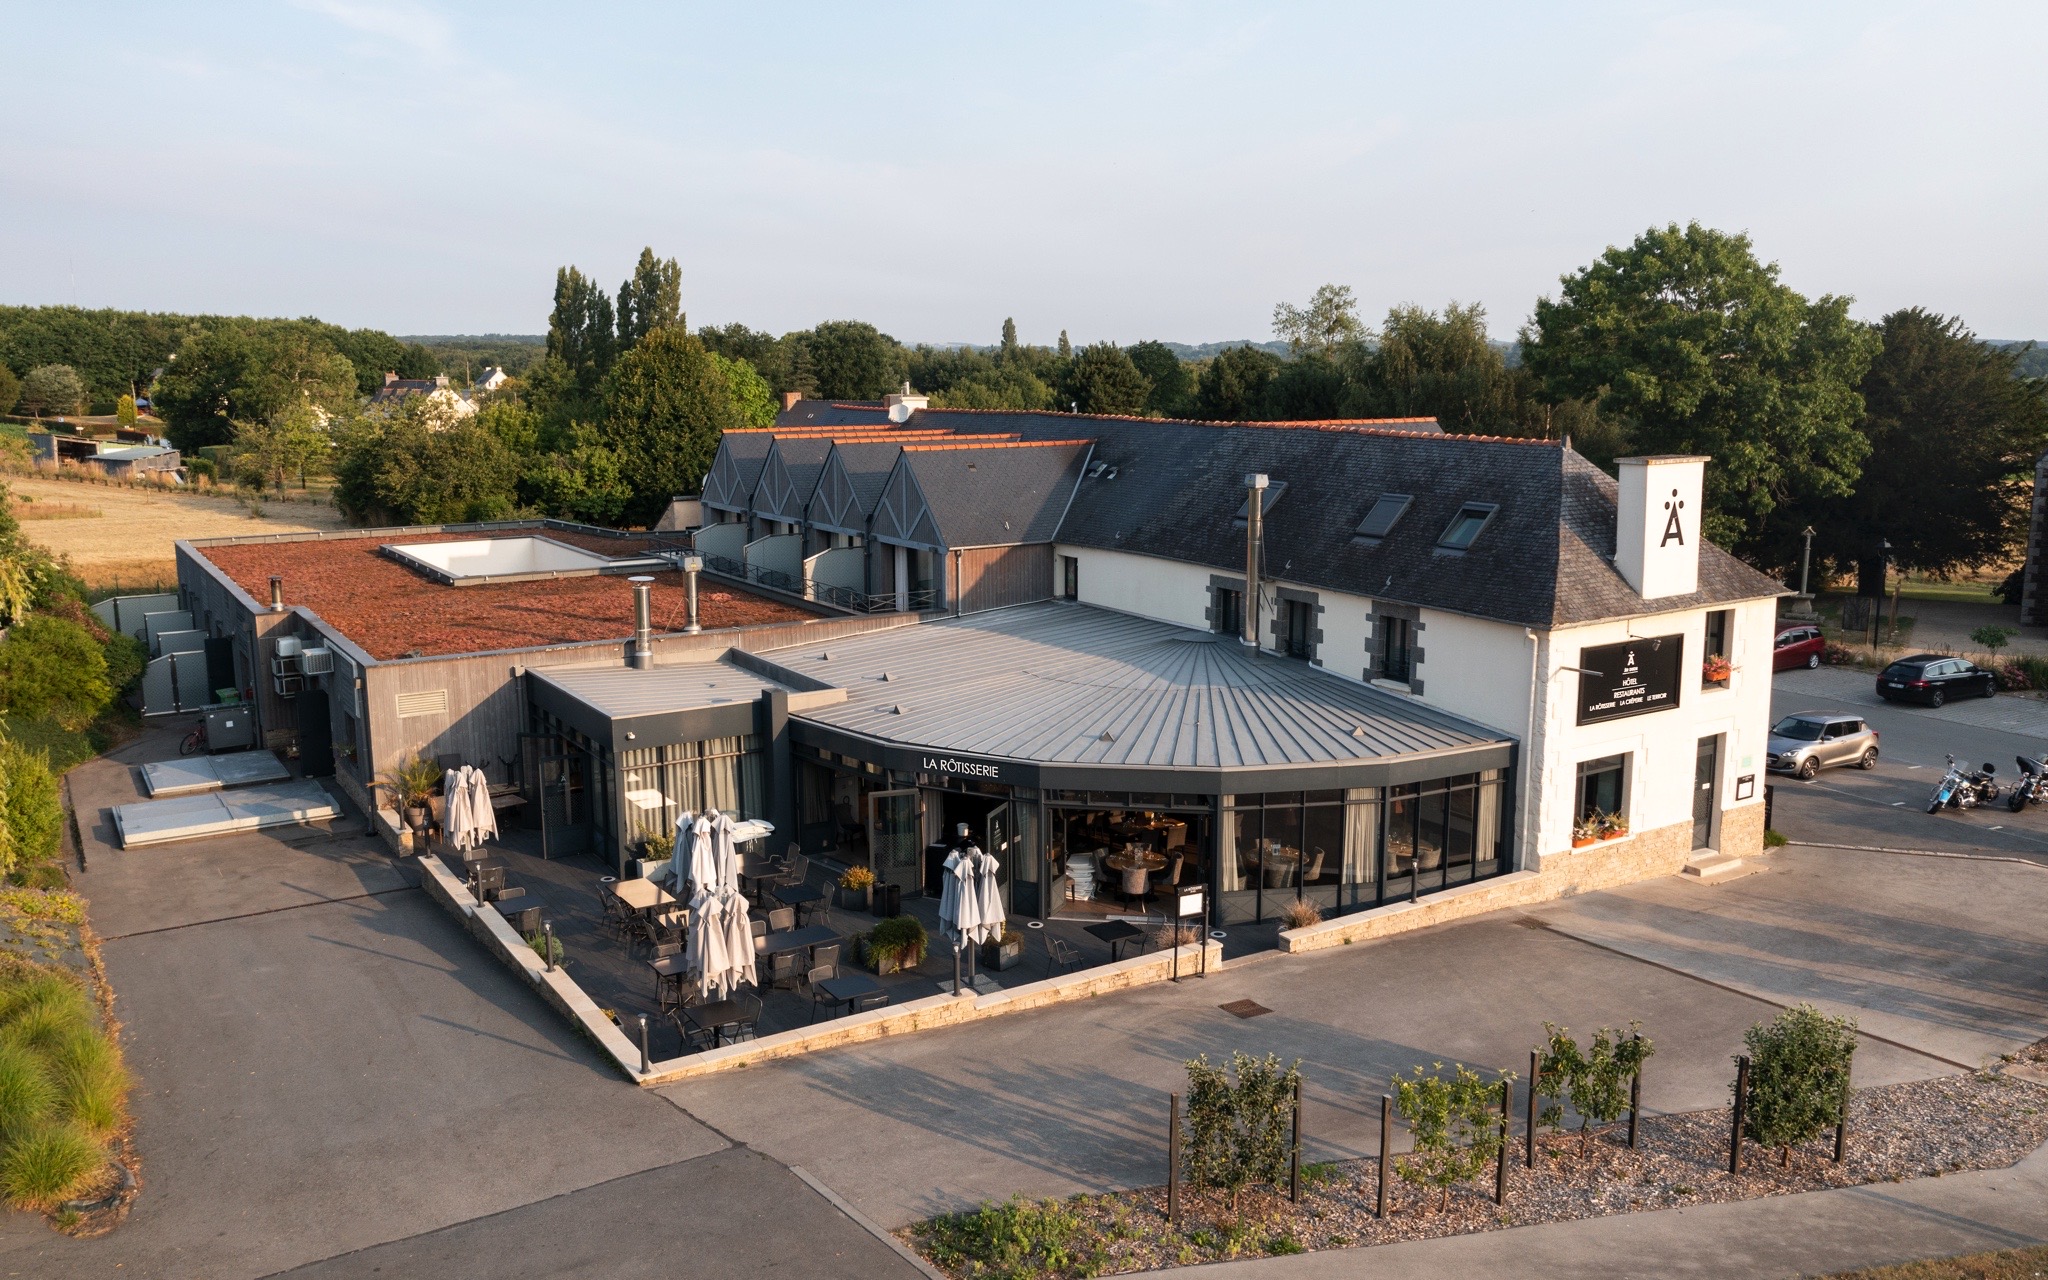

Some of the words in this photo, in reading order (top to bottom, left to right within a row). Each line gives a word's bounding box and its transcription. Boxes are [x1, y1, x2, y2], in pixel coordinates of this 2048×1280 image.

[1622, 677, 1637, 686] HÔTEL
[1614, 688, 1645, 698] RESTAURANTS
[923, 757, 938, 770] LA
[940, 758, 999, 778] RÔTISSERIE
